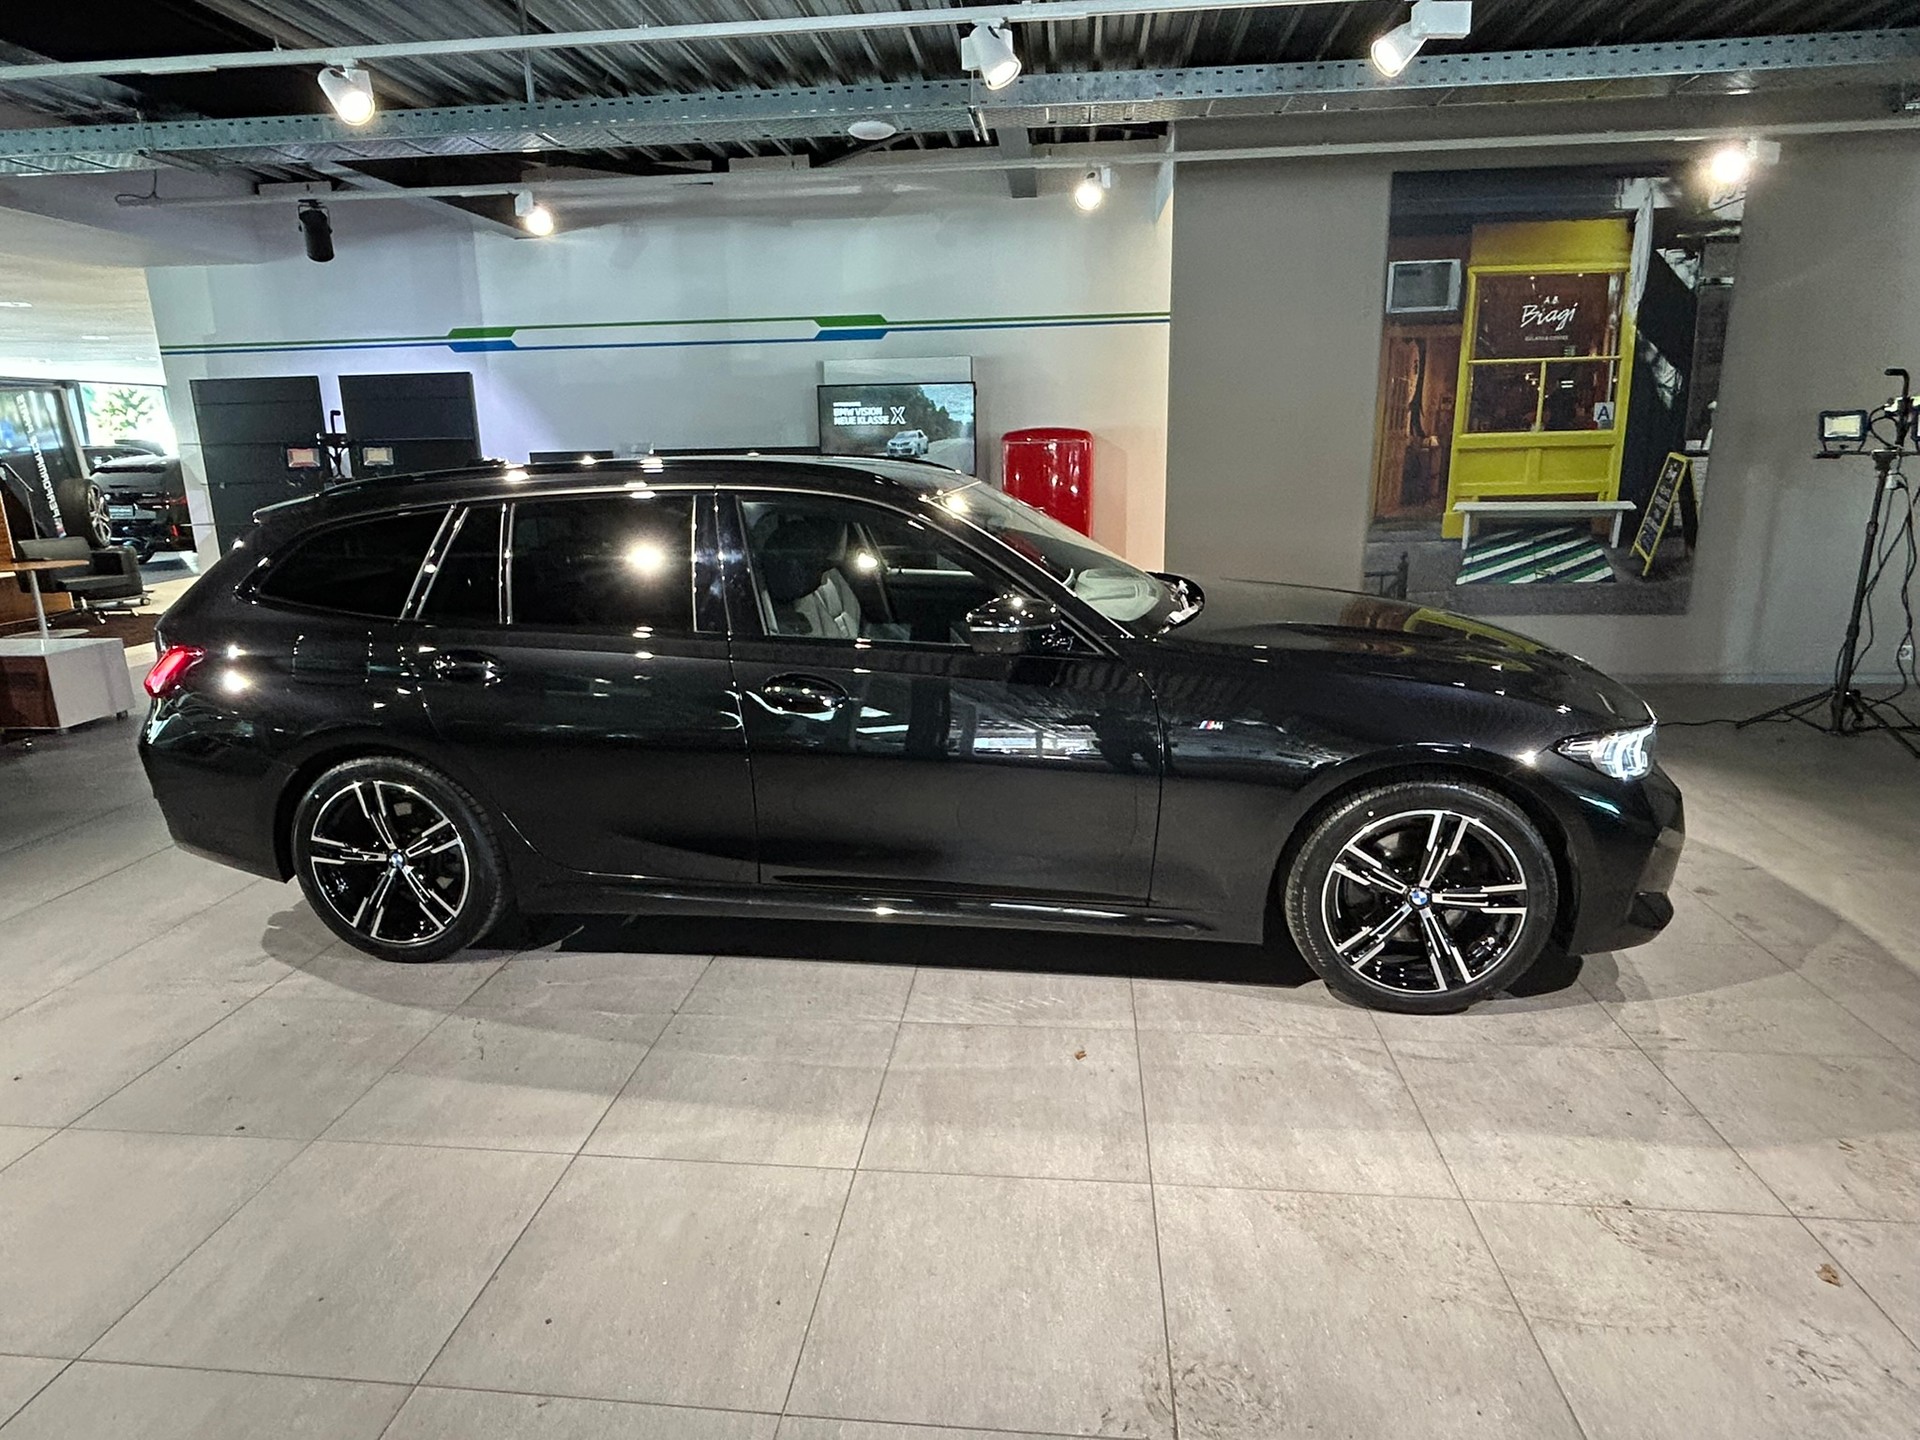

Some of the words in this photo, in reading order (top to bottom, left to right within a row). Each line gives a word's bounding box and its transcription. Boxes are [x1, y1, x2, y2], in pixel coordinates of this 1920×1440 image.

[1520, 302, 1579, 332] Biagi
[833, 408, 854, 416] BMW
[854, 406, 883, 416] VISION
[890, 406, 907, 425] X
[857, 415, 890, 425] KLASSE
[1597, 405, 1609, 420] A
